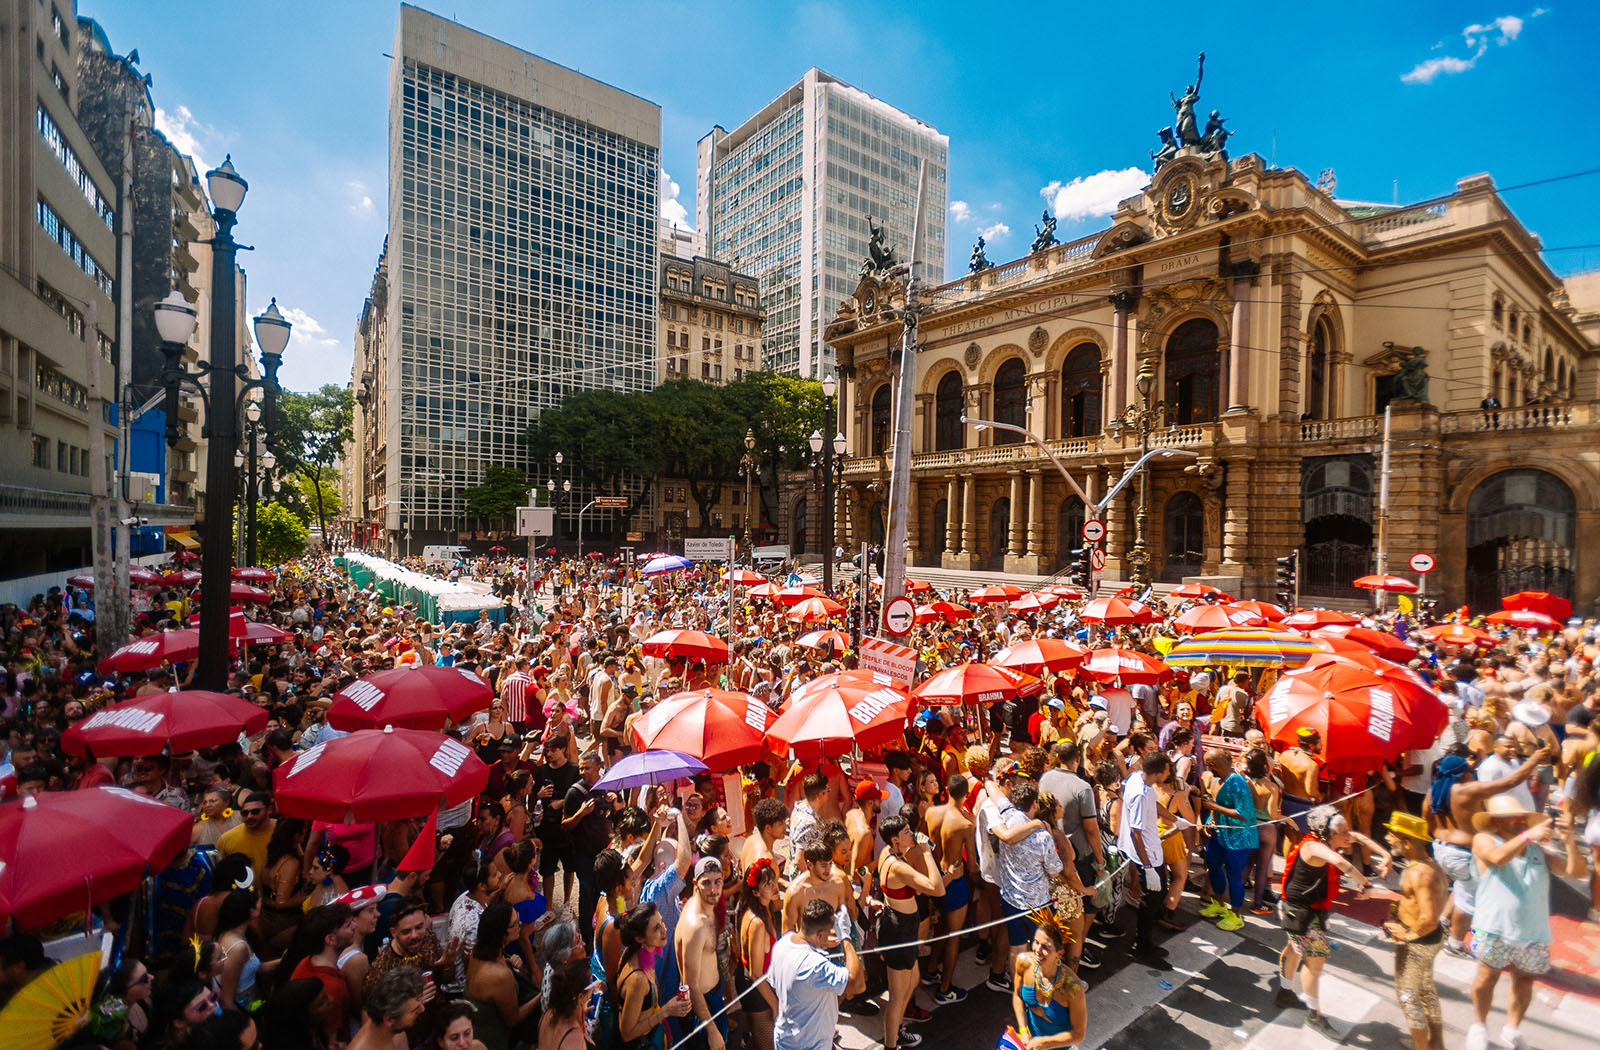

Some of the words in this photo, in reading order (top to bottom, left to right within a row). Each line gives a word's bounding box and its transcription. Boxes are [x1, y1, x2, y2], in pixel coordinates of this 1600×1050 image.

[1161, 255, 1199, 272] DRAMA
[943, 316, 994, 337] THEATRO
[862, 654, 882, 665] DESFILE
[882, 659, 890, 667] DE
[890, 662, 914, 673] BLOCOS
[978, 691, 1004, 702] BRAHMA
